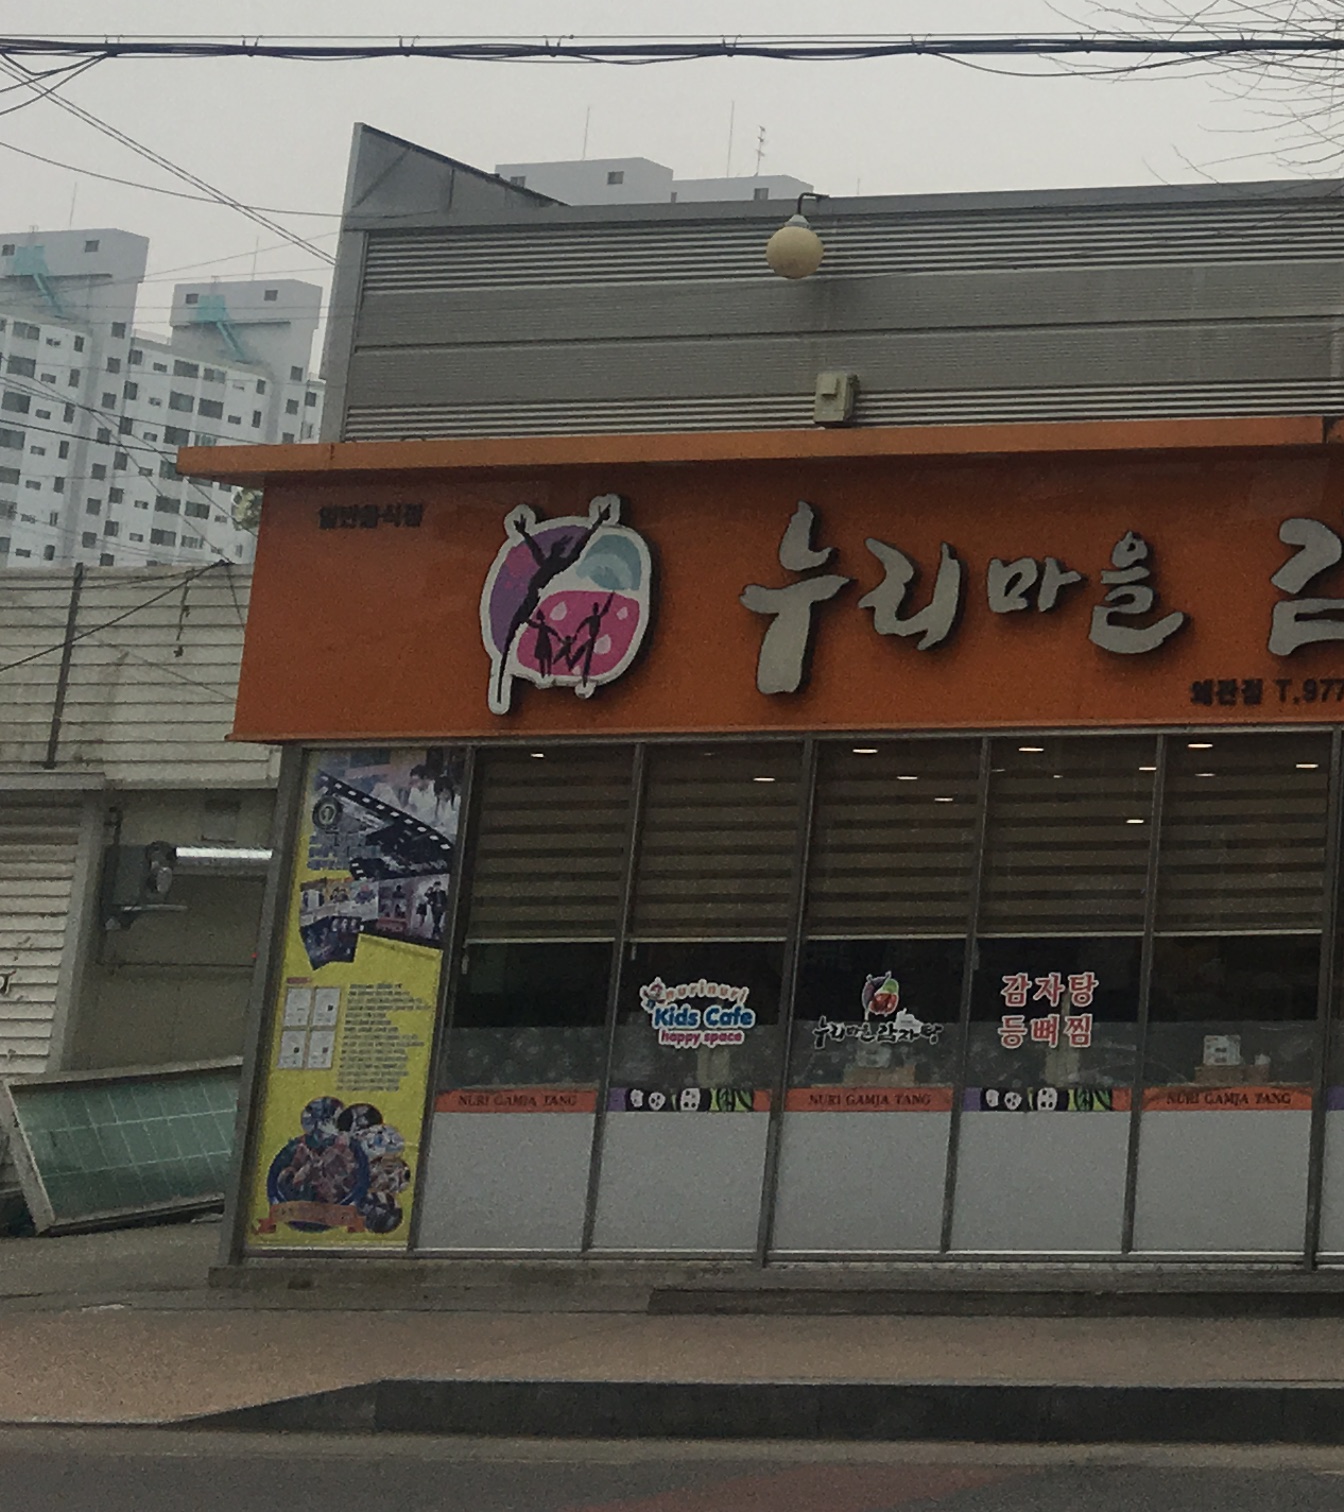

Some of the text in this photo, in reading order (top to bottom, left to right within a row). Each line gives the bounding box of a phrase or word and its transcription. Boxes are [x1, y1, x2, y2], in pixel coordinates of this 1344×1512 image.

[738, 499, 1190, 696] 누리마을
[1000, 971, 1099, 1008] 감자탕
[654, 1005, 754, 1027] Kids Cafe
[660, 1030, 743, 1047] happy space
[998, 1013, 1094, 1049] 등뼈찜
[808, 1093, 842, 1106] NURI
[895, 1093, 932, 1106] TANG
